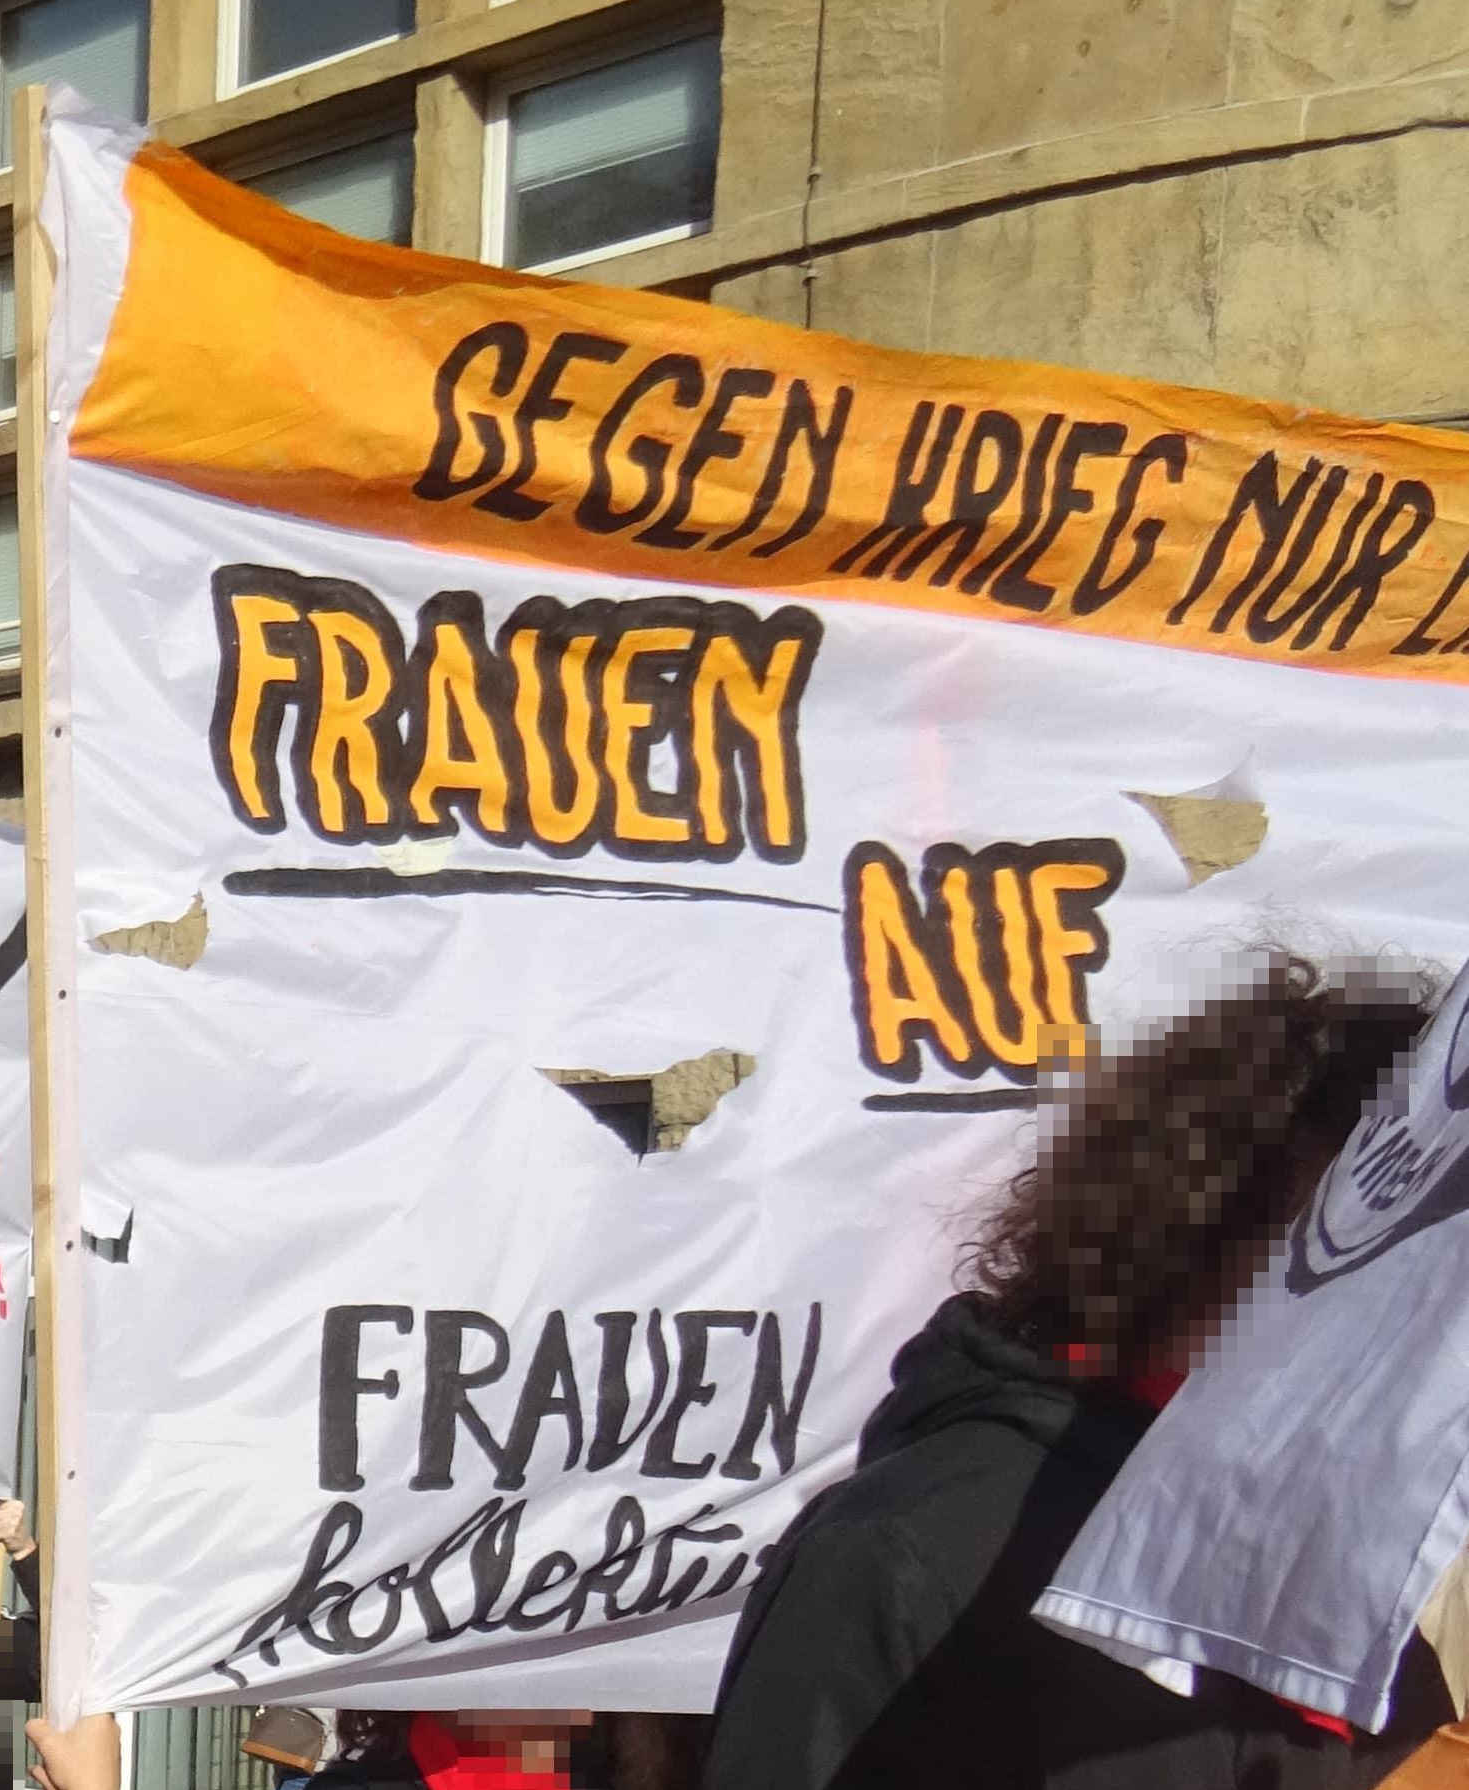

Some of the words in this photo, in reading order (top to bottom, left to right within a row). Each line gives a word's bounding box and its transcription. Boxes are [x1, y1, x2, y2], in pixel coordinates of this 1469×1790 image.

[412, 320, 854, 560] GEGEN
[829, 400, 1188, 616] KRIEG
[1165, 449, 1437, 652] NUR
[210, 562, 825, 865] FRAUEN
[842, 837, 1125, 1085] AUF
[318, 1302, 821, 1491] FRAUEN
